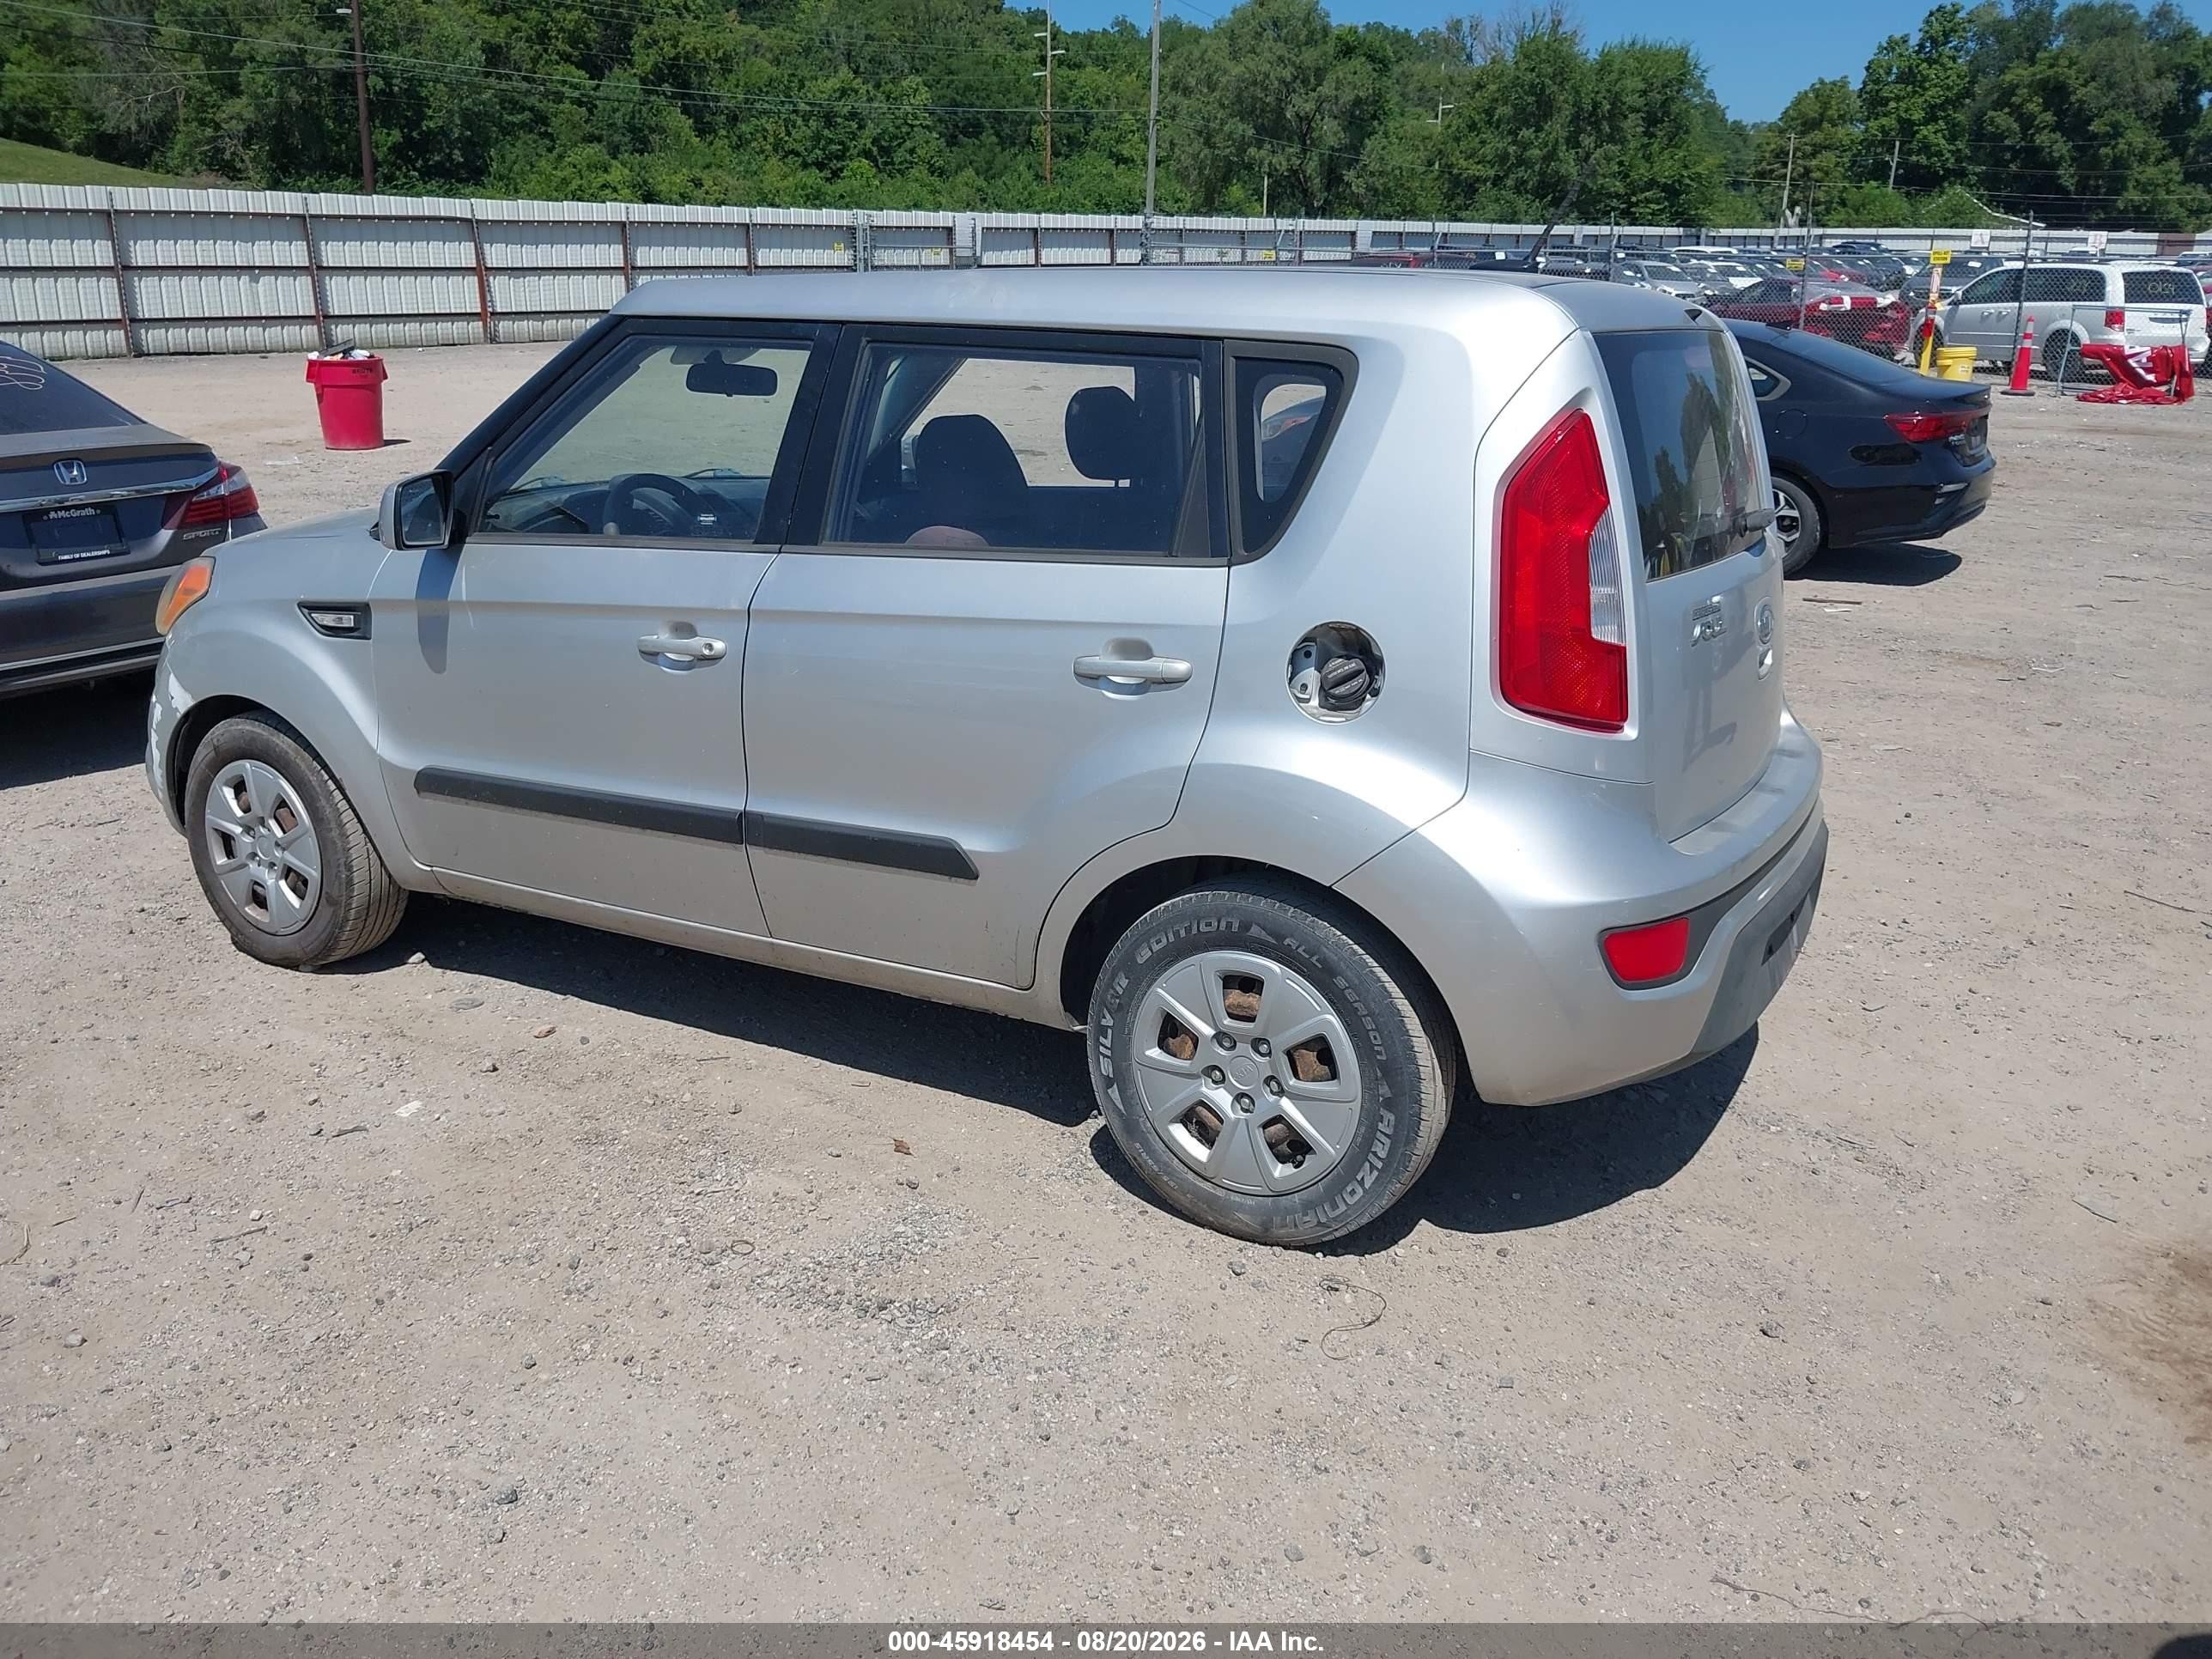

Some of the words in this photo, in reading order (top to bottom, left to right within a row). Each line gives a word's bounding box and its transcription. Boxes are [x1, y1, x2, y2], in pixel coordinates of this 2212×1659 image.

[57, 507, 95, 519] McGrath
[183, 527, 222, 540] SPORT
[1134, 917, 1241, 964] EDITION
[1283, 937, 1323, 969] ALL
[1332, 975, 1388, 1061] SEASON
